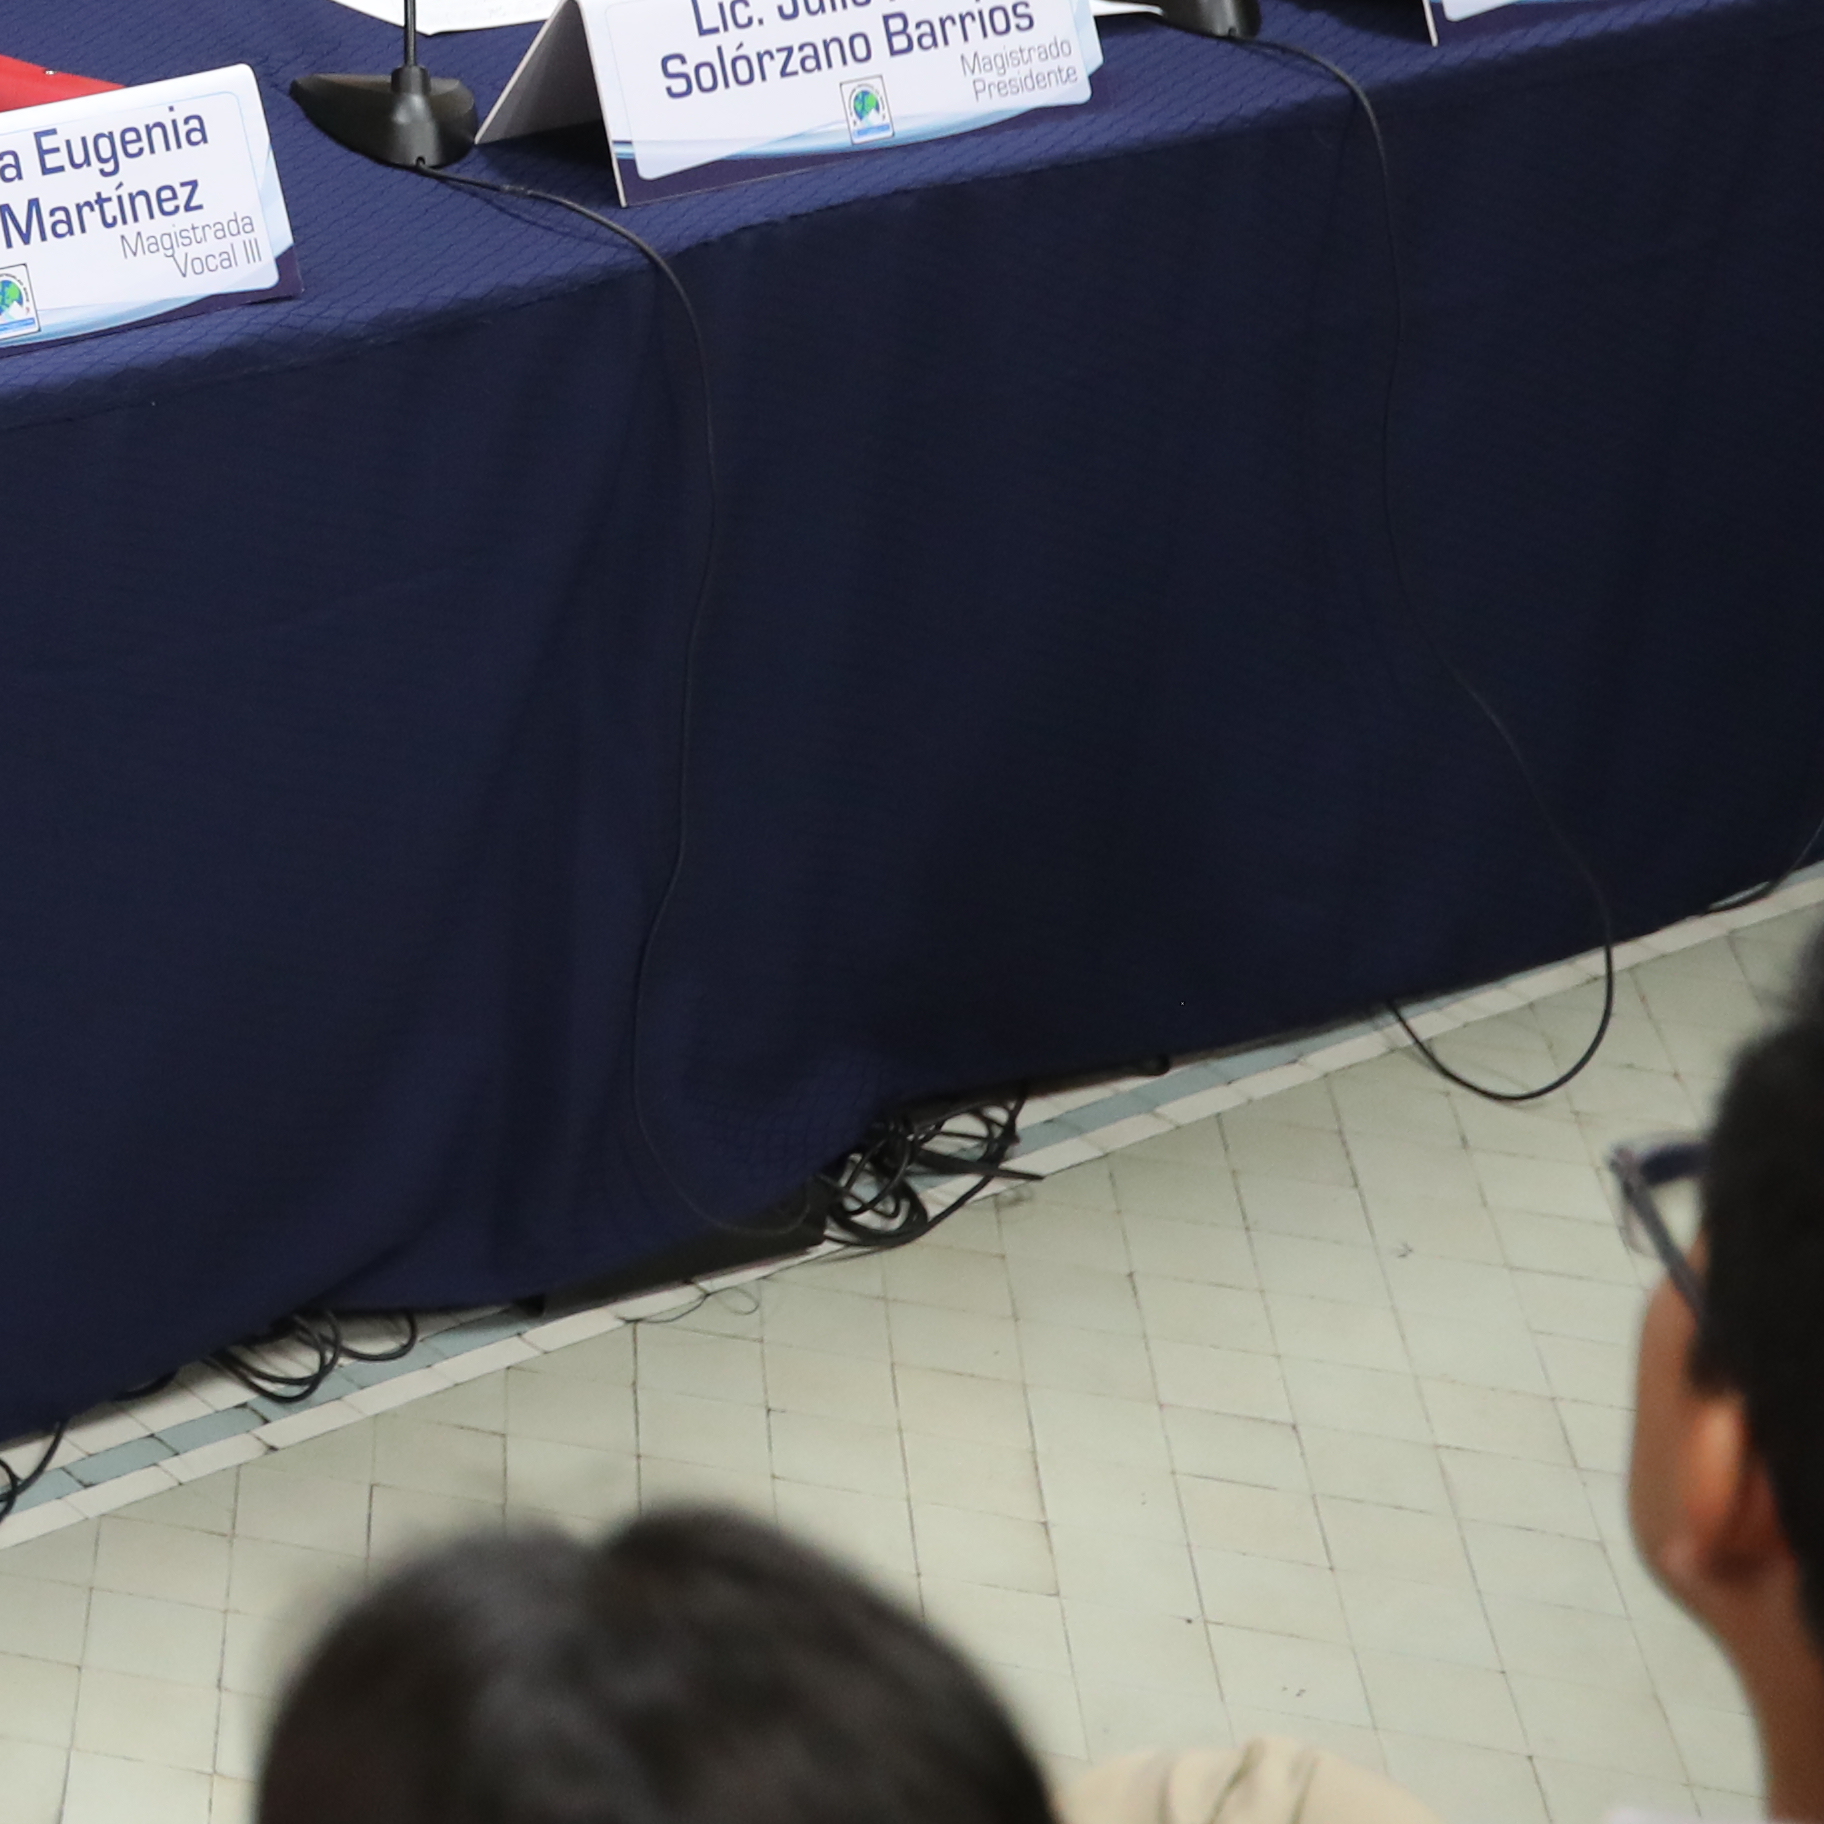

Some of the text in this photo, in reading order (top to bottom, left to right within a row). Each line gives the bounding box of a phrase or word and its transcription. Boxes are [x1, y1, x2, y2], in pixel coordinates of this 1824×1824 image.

[660, 31, 873, 100] Solórzano
[960, 36, 1072, 78] Magistrado
[972, 64, 1077, 102] Presidente
[32, 104, 209, 179] Eugenia
[119, 210, 256, 262] Magistrada
[172, 237, 263, 280] Vocal III
